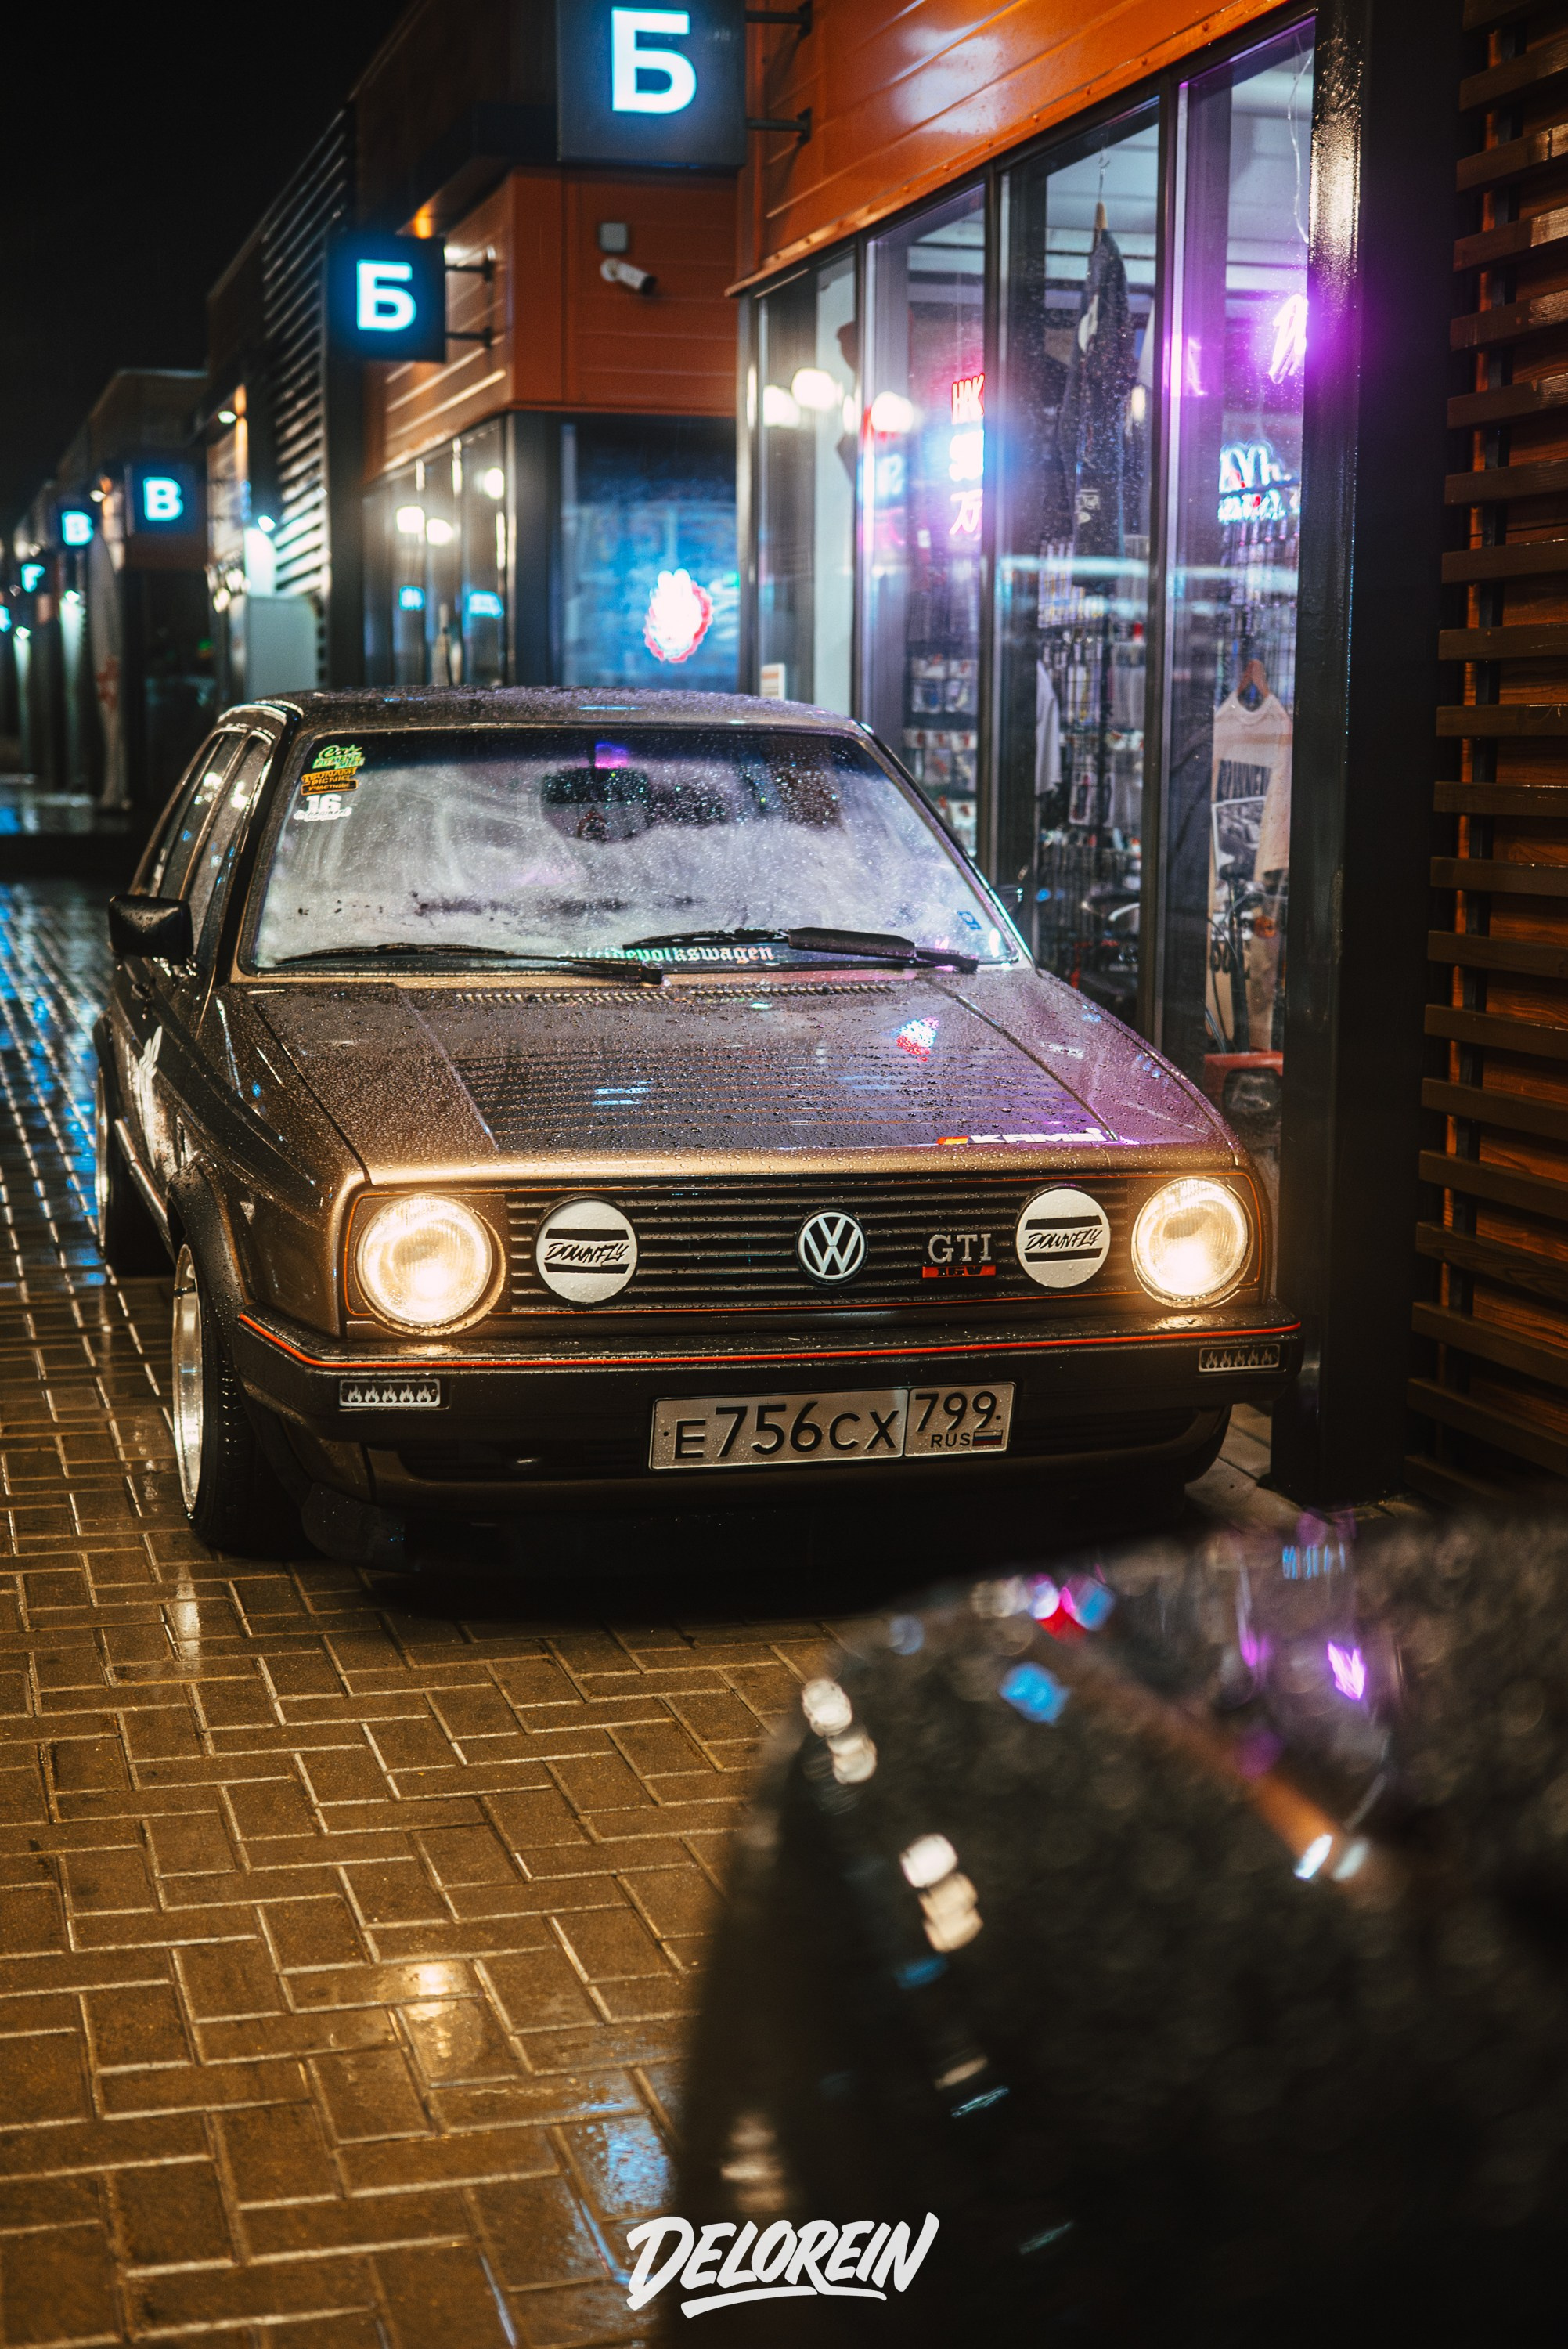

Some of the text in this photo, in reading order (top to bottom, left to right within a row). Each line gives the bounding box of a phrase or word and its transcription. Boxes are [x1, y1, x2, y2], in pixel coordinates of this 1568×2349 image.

[611, 6, 696, 114] Б
[357, 259, 416, 332] Б
[143, 477, 184, 521] В
[306, 794, 341, 811] 16
[544, 1243, 629, 1264] DOWNFLY
[928, 1234, 991, 1263] GTI
[1025, 1229, 1102, 1251] DOWNFLY
[914, 1391, 997, 1432] 799
[931, 1432, 971, 1448] RUS
